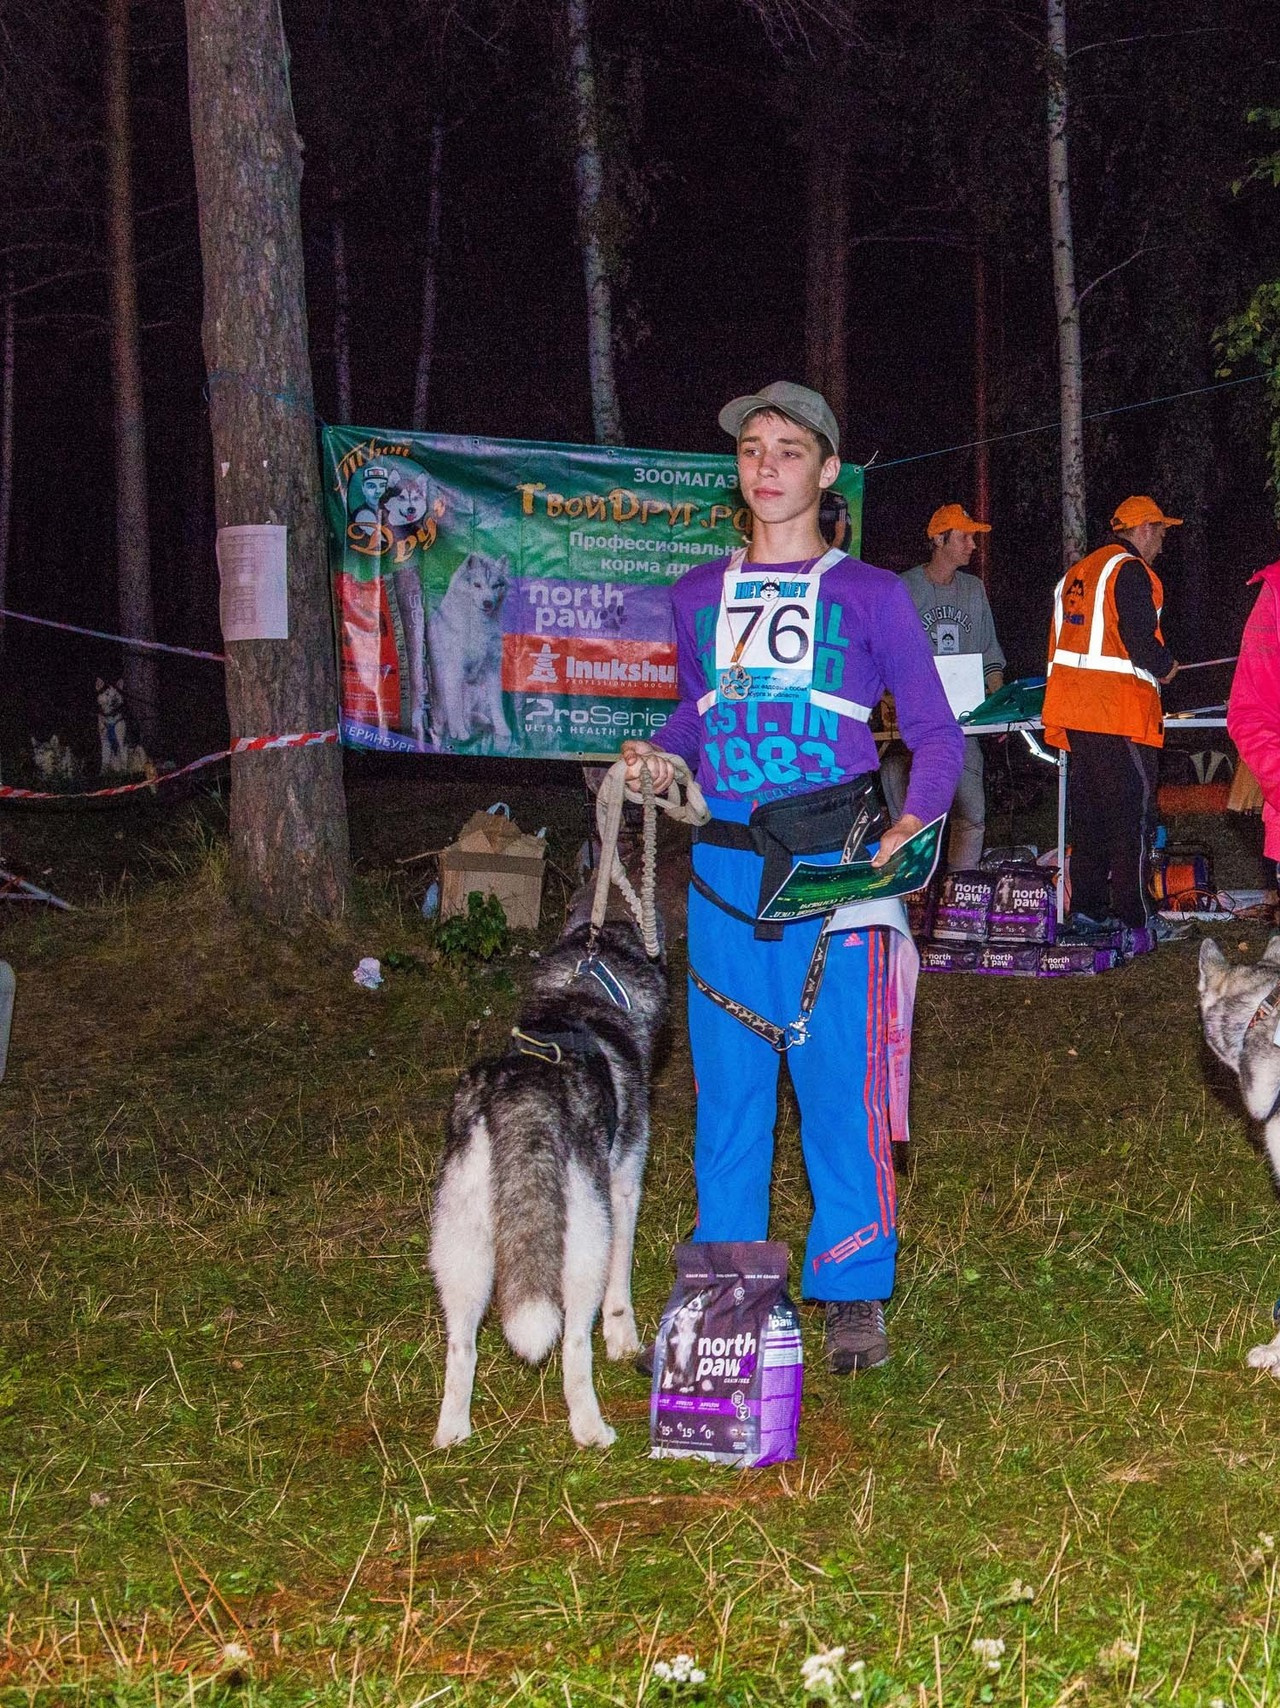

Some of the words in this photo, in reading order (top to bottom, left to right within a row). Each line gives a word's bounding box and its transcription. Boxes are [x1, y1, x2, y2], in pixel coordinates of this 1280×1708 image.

[633, 467, 739, 489] ЗООМАГАЗ
[600, 557, 661, 575] корма
[529, 583, 624, 609] north
[734, 581, 762, 600] HEY
[778, 581, 811, 598] HEY
[535, 605, 602, 633] paw
[726, 603, 810, 664] 76
[565, 655, 678, 683] Inukshu
[524, 698, 671, 728] ProSerie
[790, 701, 839, 742] IN
[524, 723, 563, 734] ULTRA
[570, 726, 616, 737] HEALTH
[623, 728, 644, 738] PET
[704, 735, 846, 794] 1983
[954, 882, 992, 894] north
[955, 891, 982, 903] paw
[1012, 887, 1048, 899] north
[1013, 897, 1041, 909] paw
[928, 952, 952, 962] north
[930, 959, 947, 967] paw
[990, 953, 1014, 962] north
[991, 960, 1008, 968] paw
[1047, 956, 1071, 964] north
[1049, 962, 1065, 970] paw
[697, 1332, 757, 1357] north
[695, 1357, 742, 1382] paw
